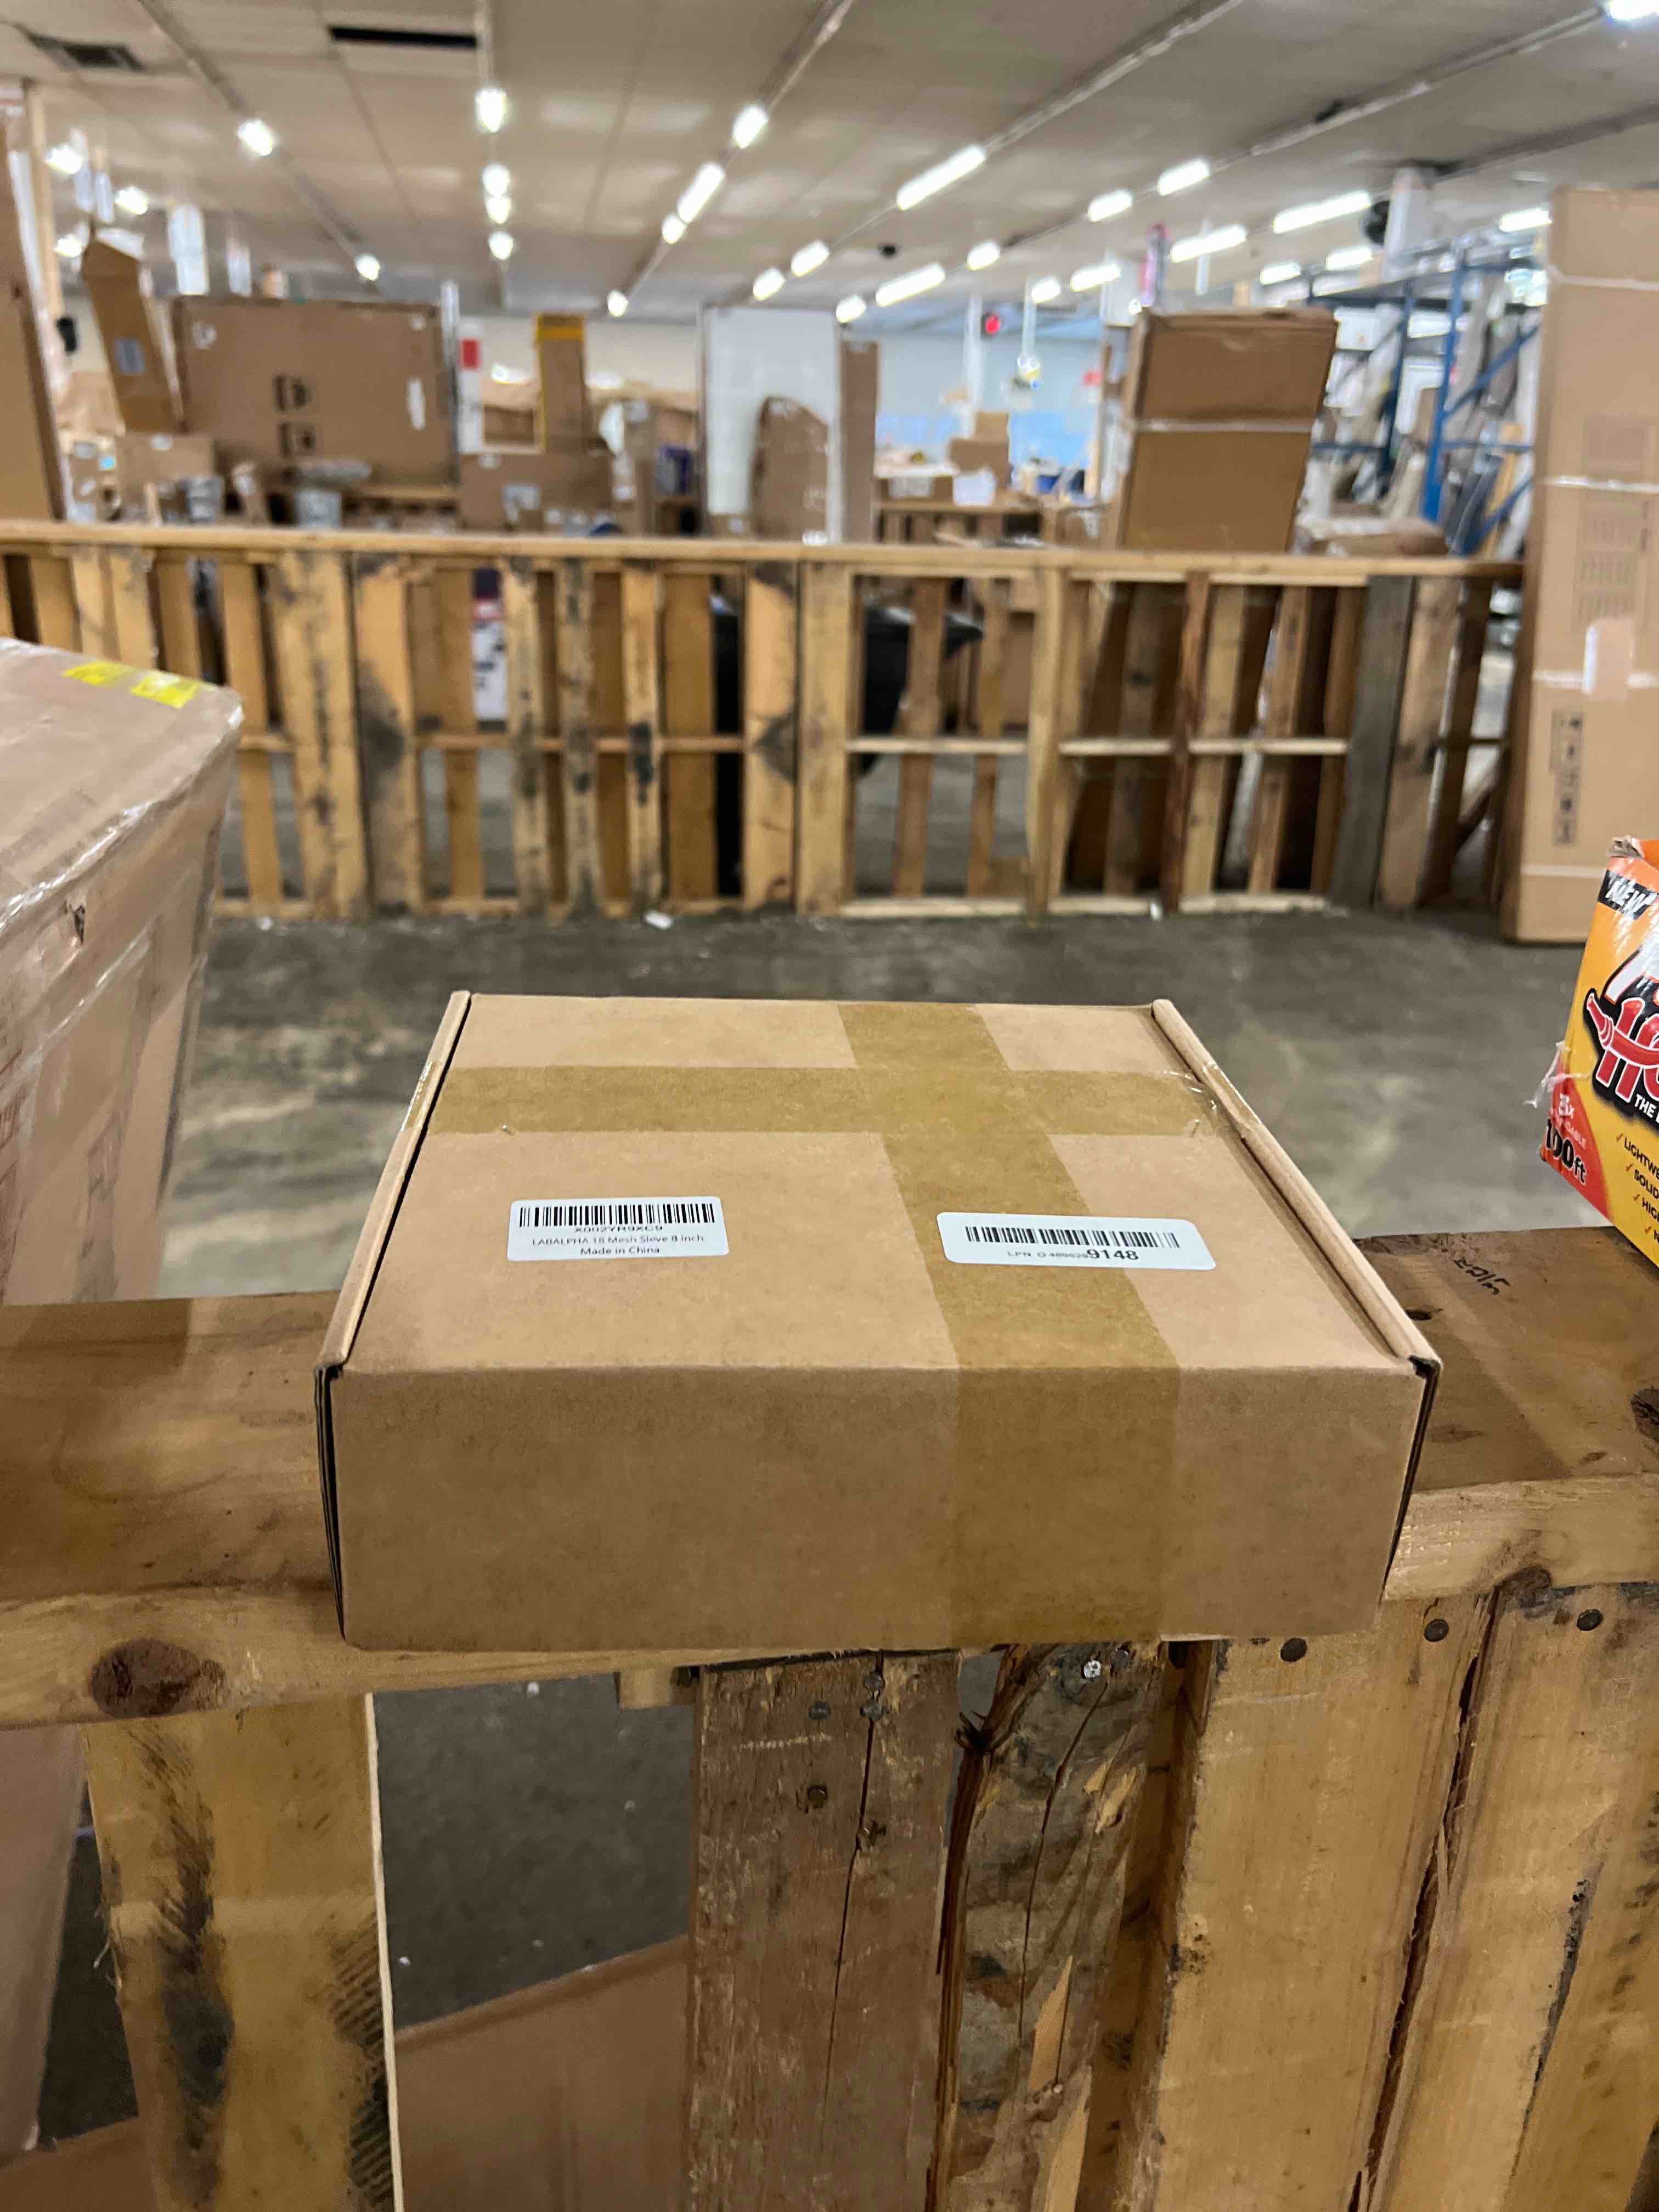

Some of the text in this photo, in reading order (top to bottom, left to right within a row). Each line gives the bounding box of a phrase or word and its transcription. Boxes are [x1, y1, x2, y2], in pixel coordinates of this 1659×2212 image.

[1605, 878, 1657, 912] NEW
[1634, 1094, 1656, 1118] THE
[580, 1247, 612, 1255] Made
[629, 1246, 659, 1254] China
